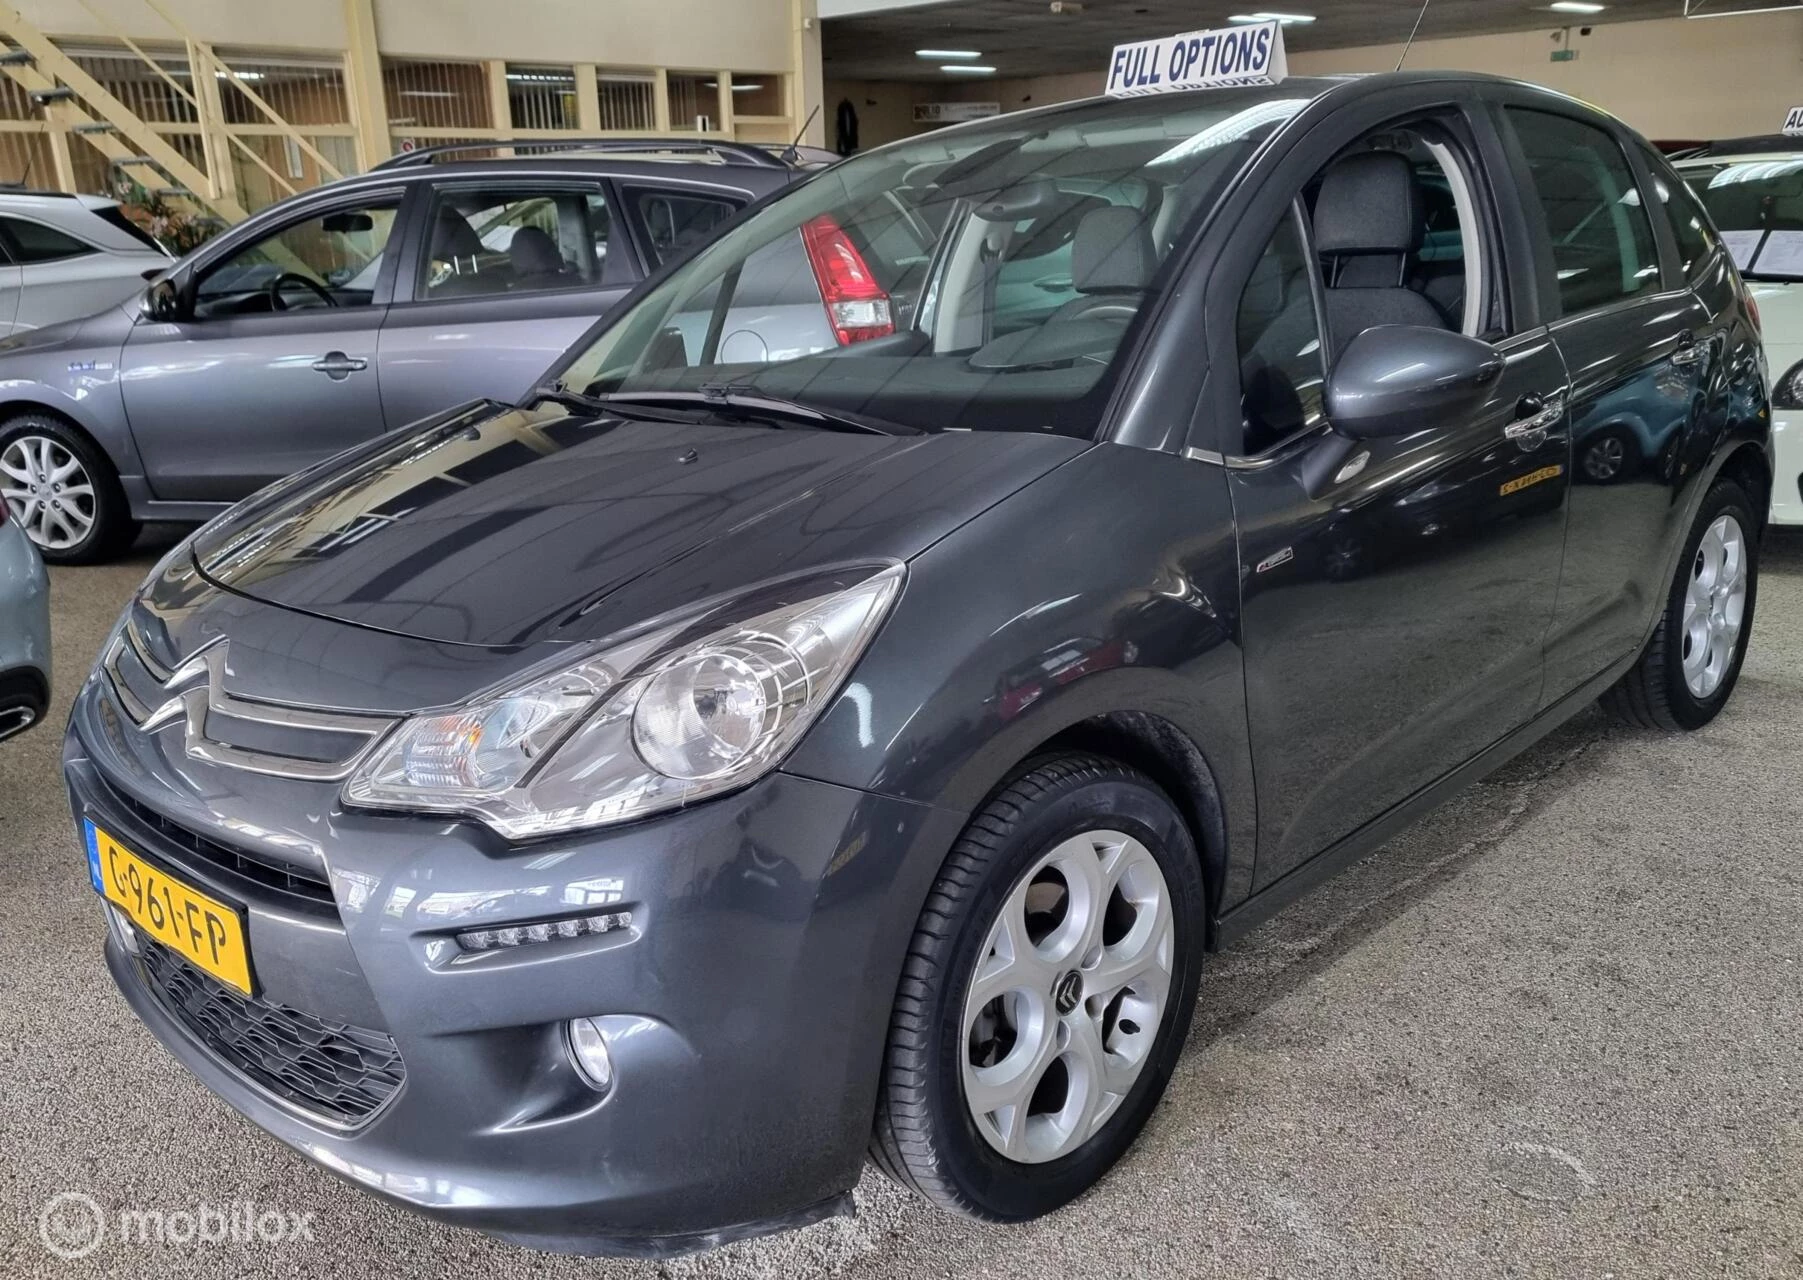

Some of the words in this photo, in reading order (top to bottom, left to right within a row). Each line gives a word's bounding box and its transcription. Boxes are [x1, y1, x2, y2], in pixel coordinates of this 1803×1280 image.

[1110, 44, 1161, 90] FULL
[1168, 27, 1270, 82] OPTIONS
[109, 846, 226, 965] G-961-FP
